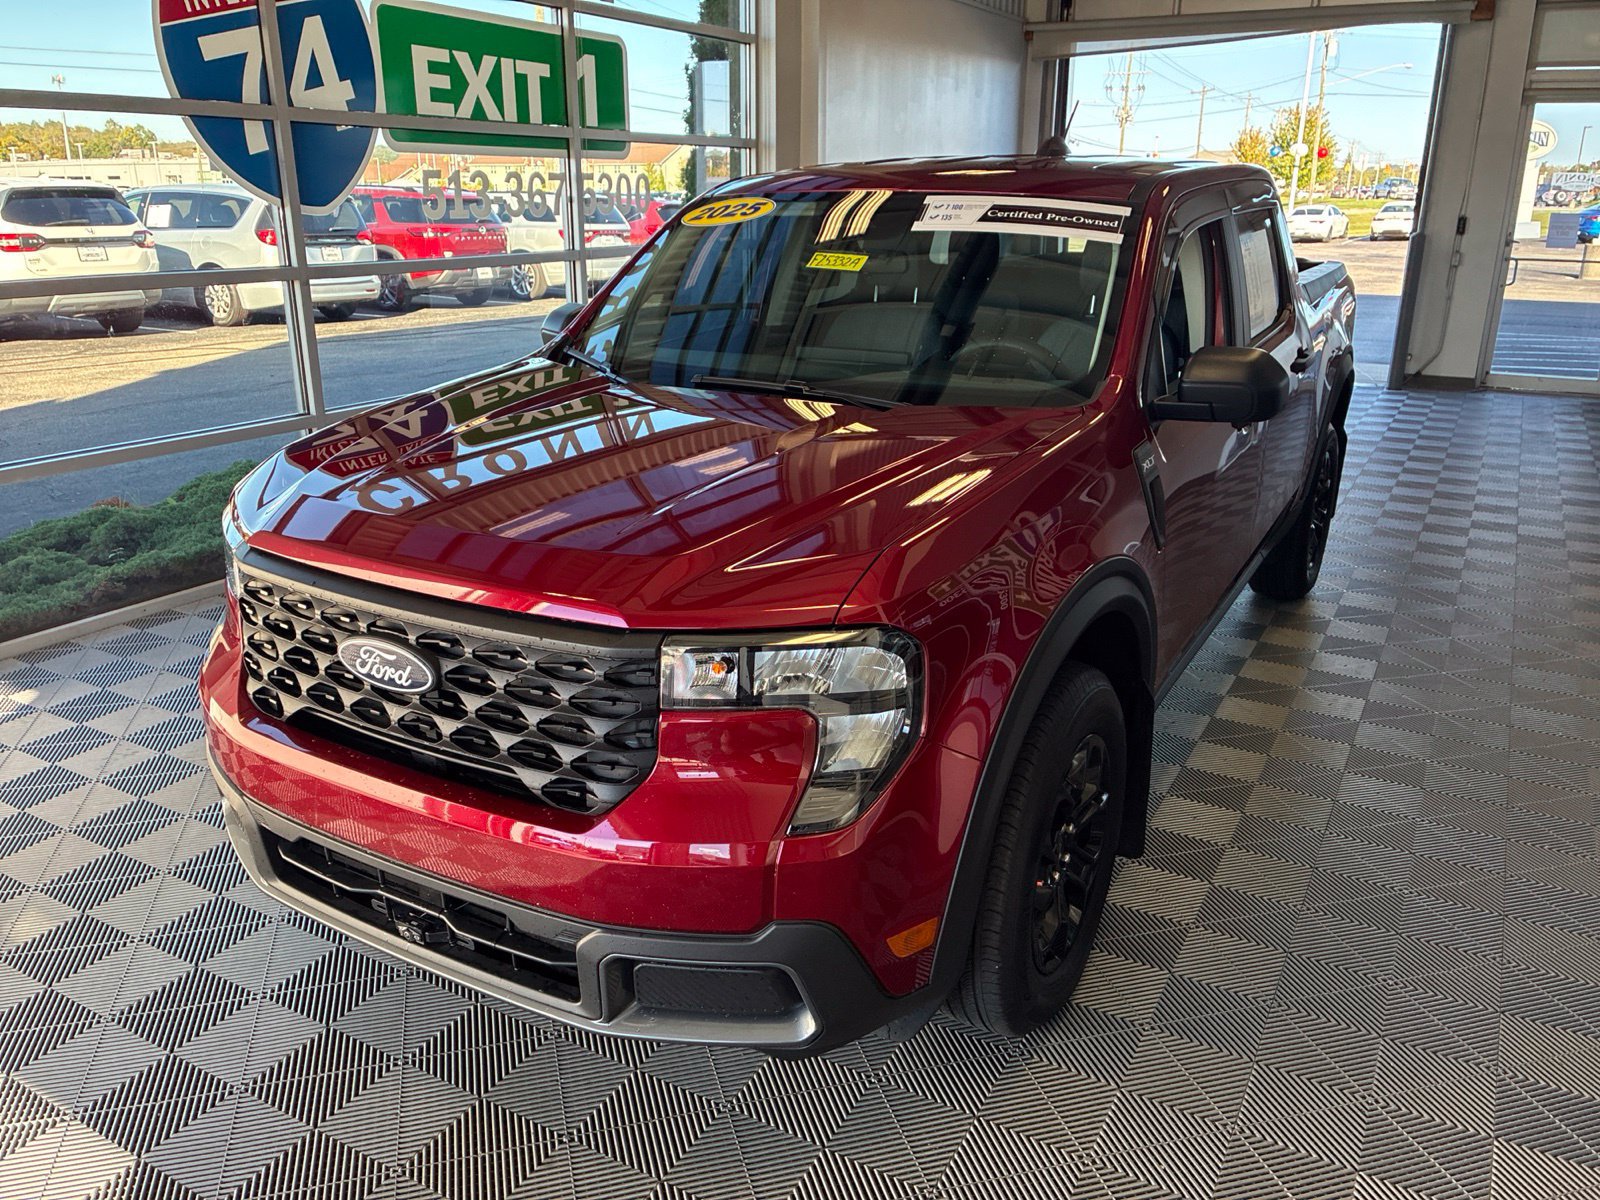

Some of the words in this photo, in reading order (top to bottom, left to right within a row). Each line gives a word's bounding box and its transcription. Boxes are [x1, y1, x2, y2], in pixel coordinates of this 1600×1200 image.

[411, 44, 551, 124] EXIT
[576, 54, 599, 128] 1
[687, 201, 769, 221] 2025
[986, 209, 1043, 221] Certified
[1046, 212, 1119, 228] Pre-Owned
[1141, 454, 1155, 473] XLT
[355, 645, 412, 687] Ford
